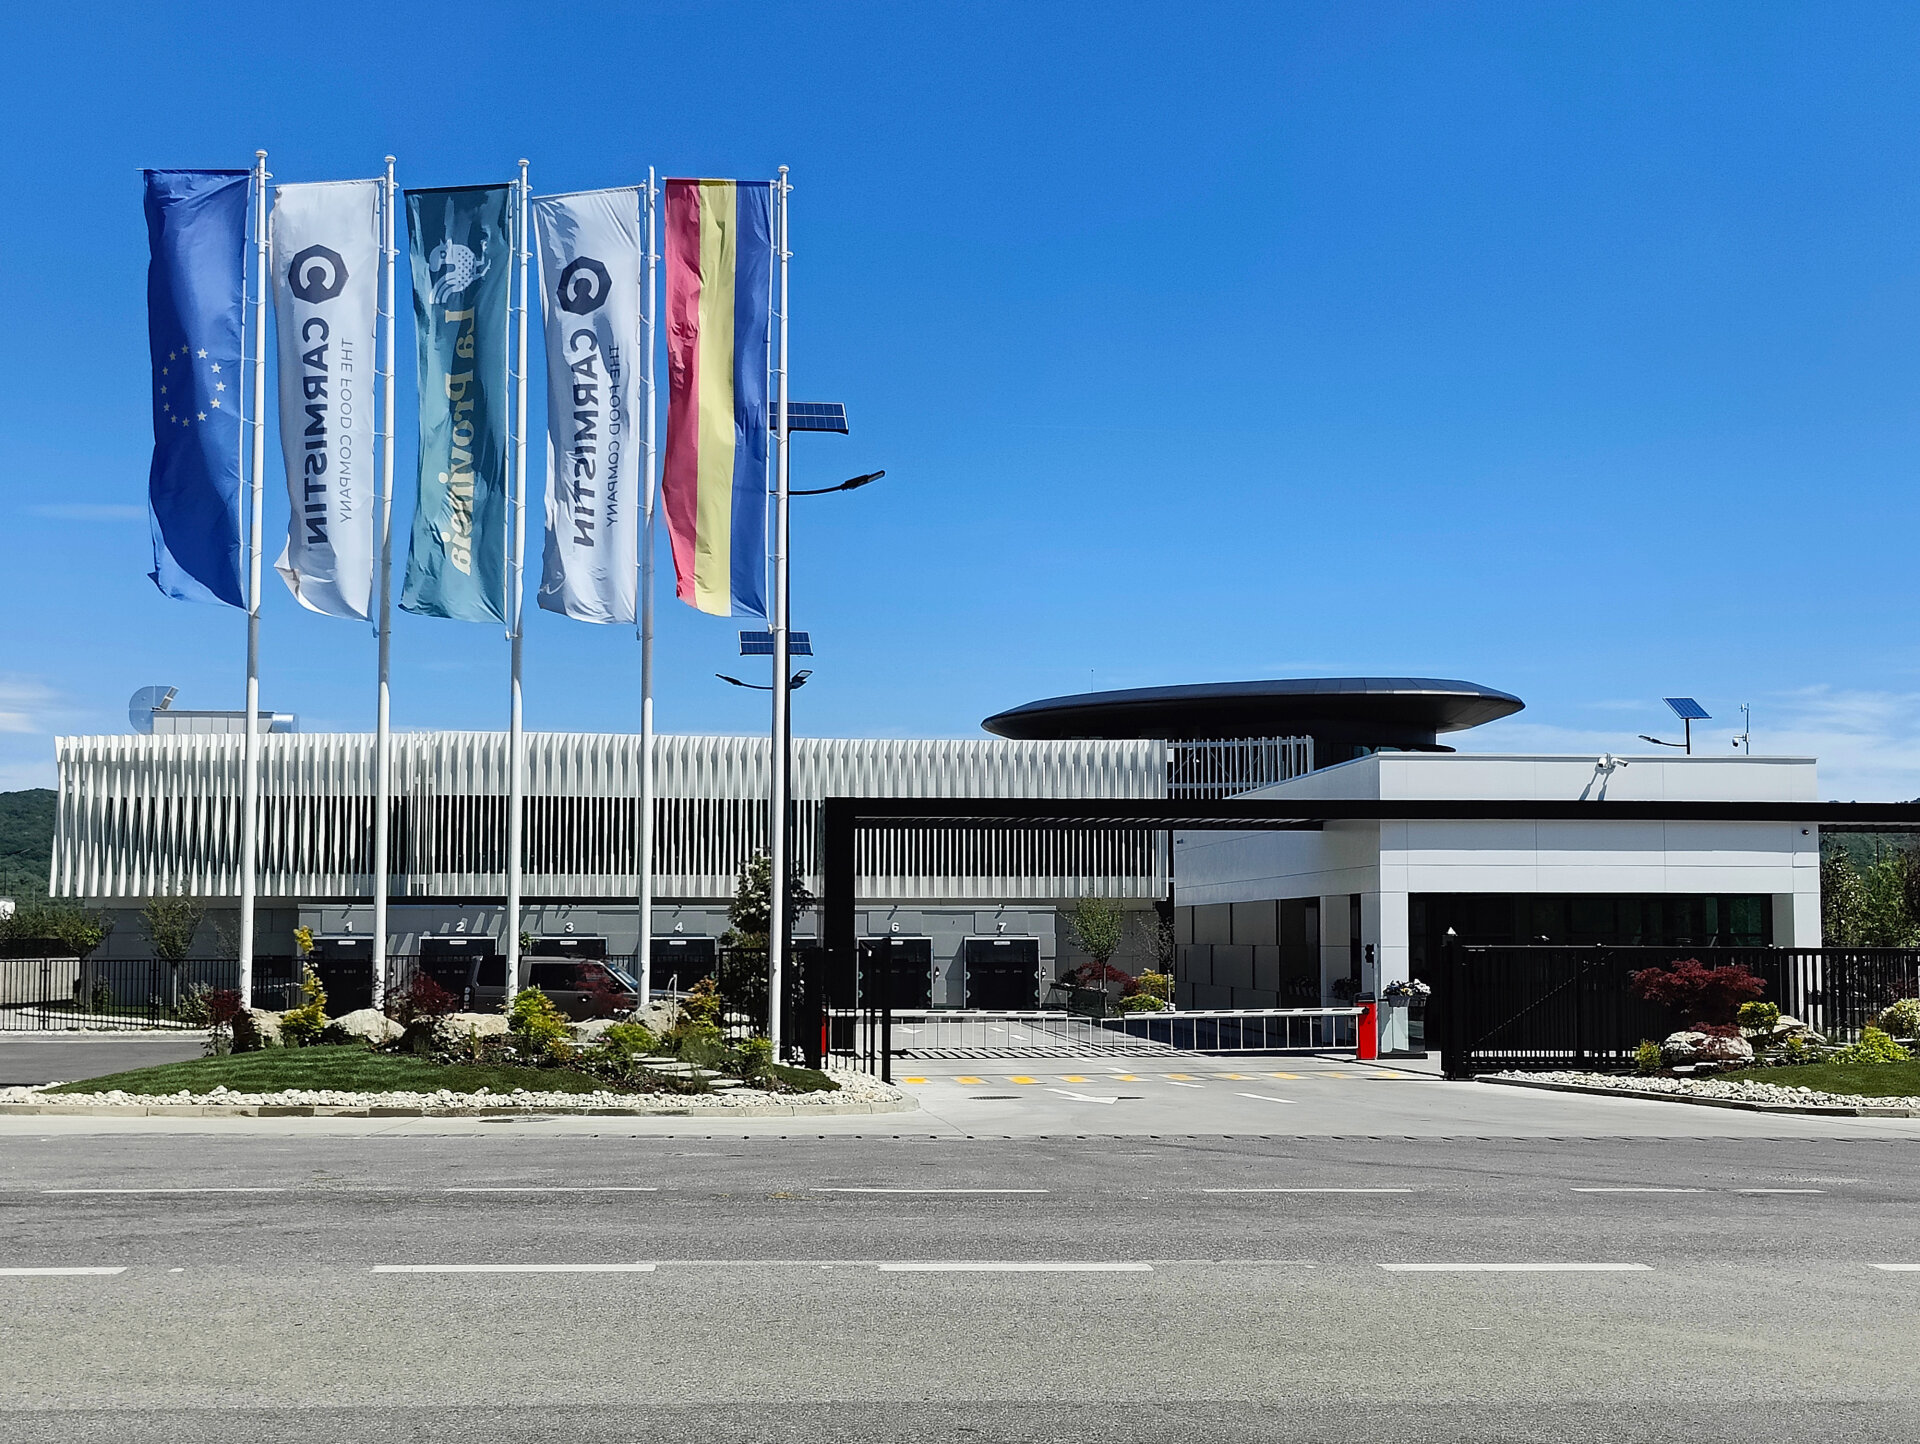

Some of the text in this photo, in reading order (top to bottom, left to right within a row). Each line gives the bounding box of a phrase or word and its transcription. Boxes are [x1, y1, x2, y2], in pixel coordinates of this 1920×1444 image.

[345, 921, 353, 932] 1
[455, 921, 465, 932] 2
[565, 921, 575, 932] 3
[674, 921, 684, 932] 4
[890, 922, 900, 933] 6
[998, 922, 1007, 932] 7
